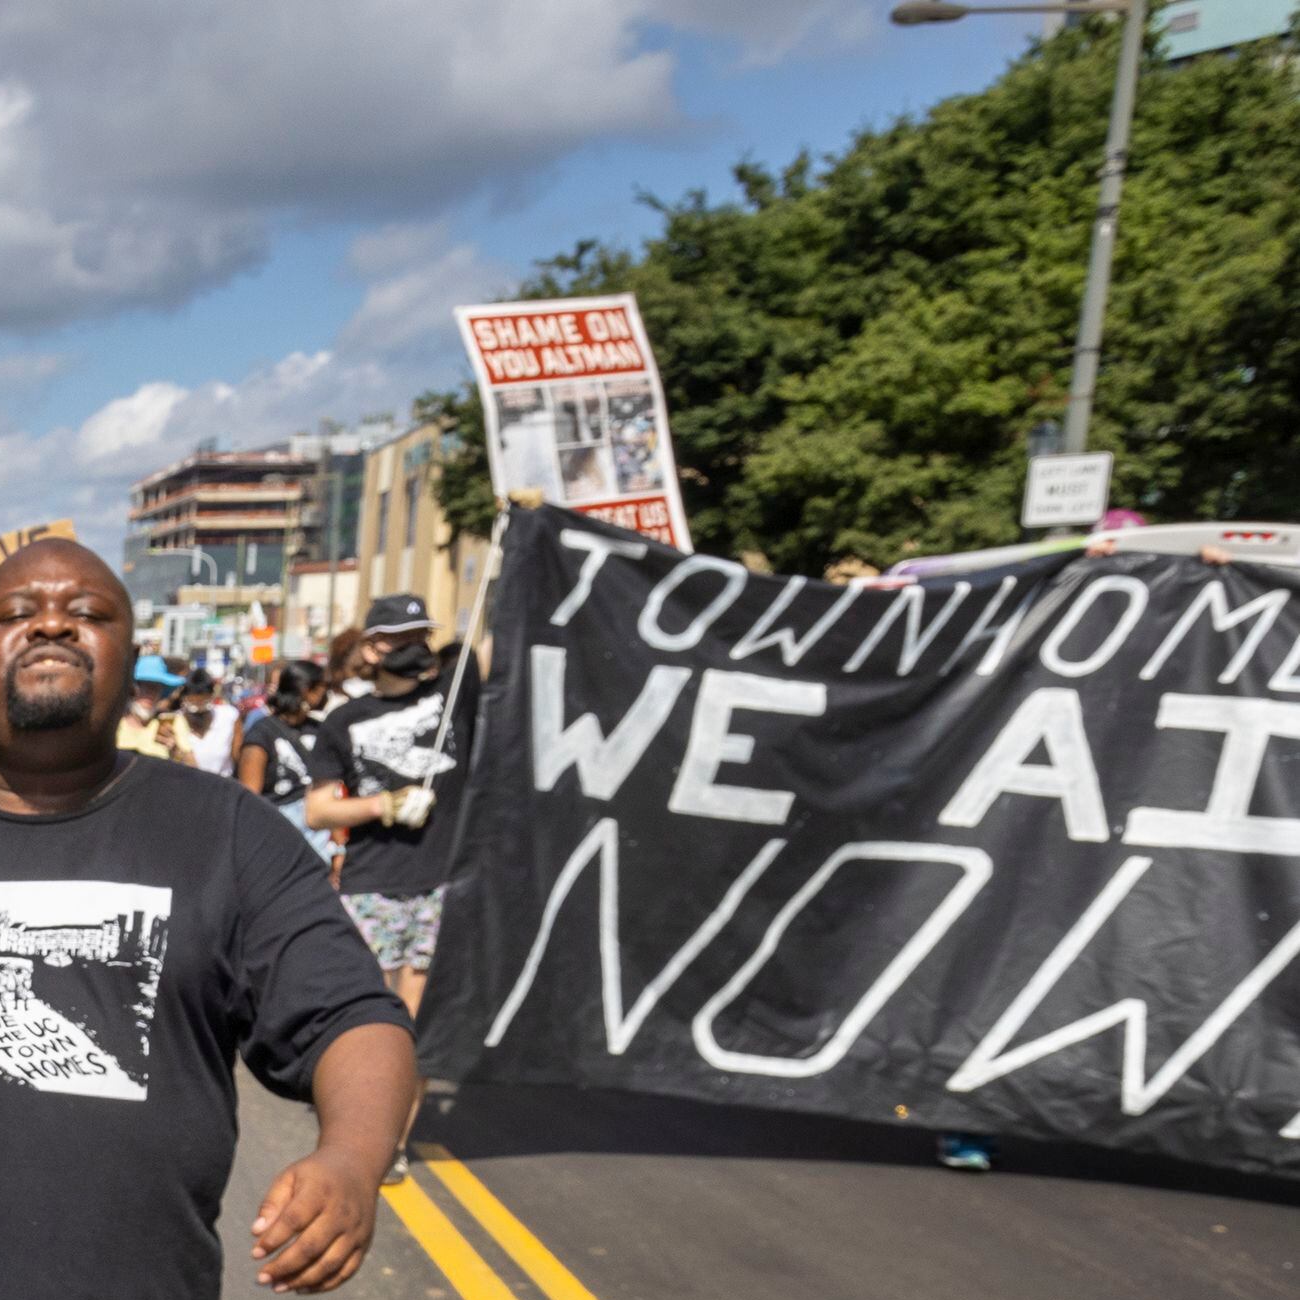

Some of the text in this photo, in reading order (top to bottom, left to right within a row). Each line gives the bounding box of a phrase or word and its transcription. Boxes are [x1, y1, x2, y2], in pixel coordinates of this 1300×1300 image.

[473, 310, 633, 351] SHAME ON
[485, 340, 644, 380] YOU ALTMAN
[586, 504, 637, 530] EAT
[550, 528, 1300, 692] TOWNHOM
[531, 645, 827, 825] WE
[484, 817, 1300, 1138] NOW
[24, 1018, 60, 1038] UC
[15, 1052, 108, 1079] HOMES
